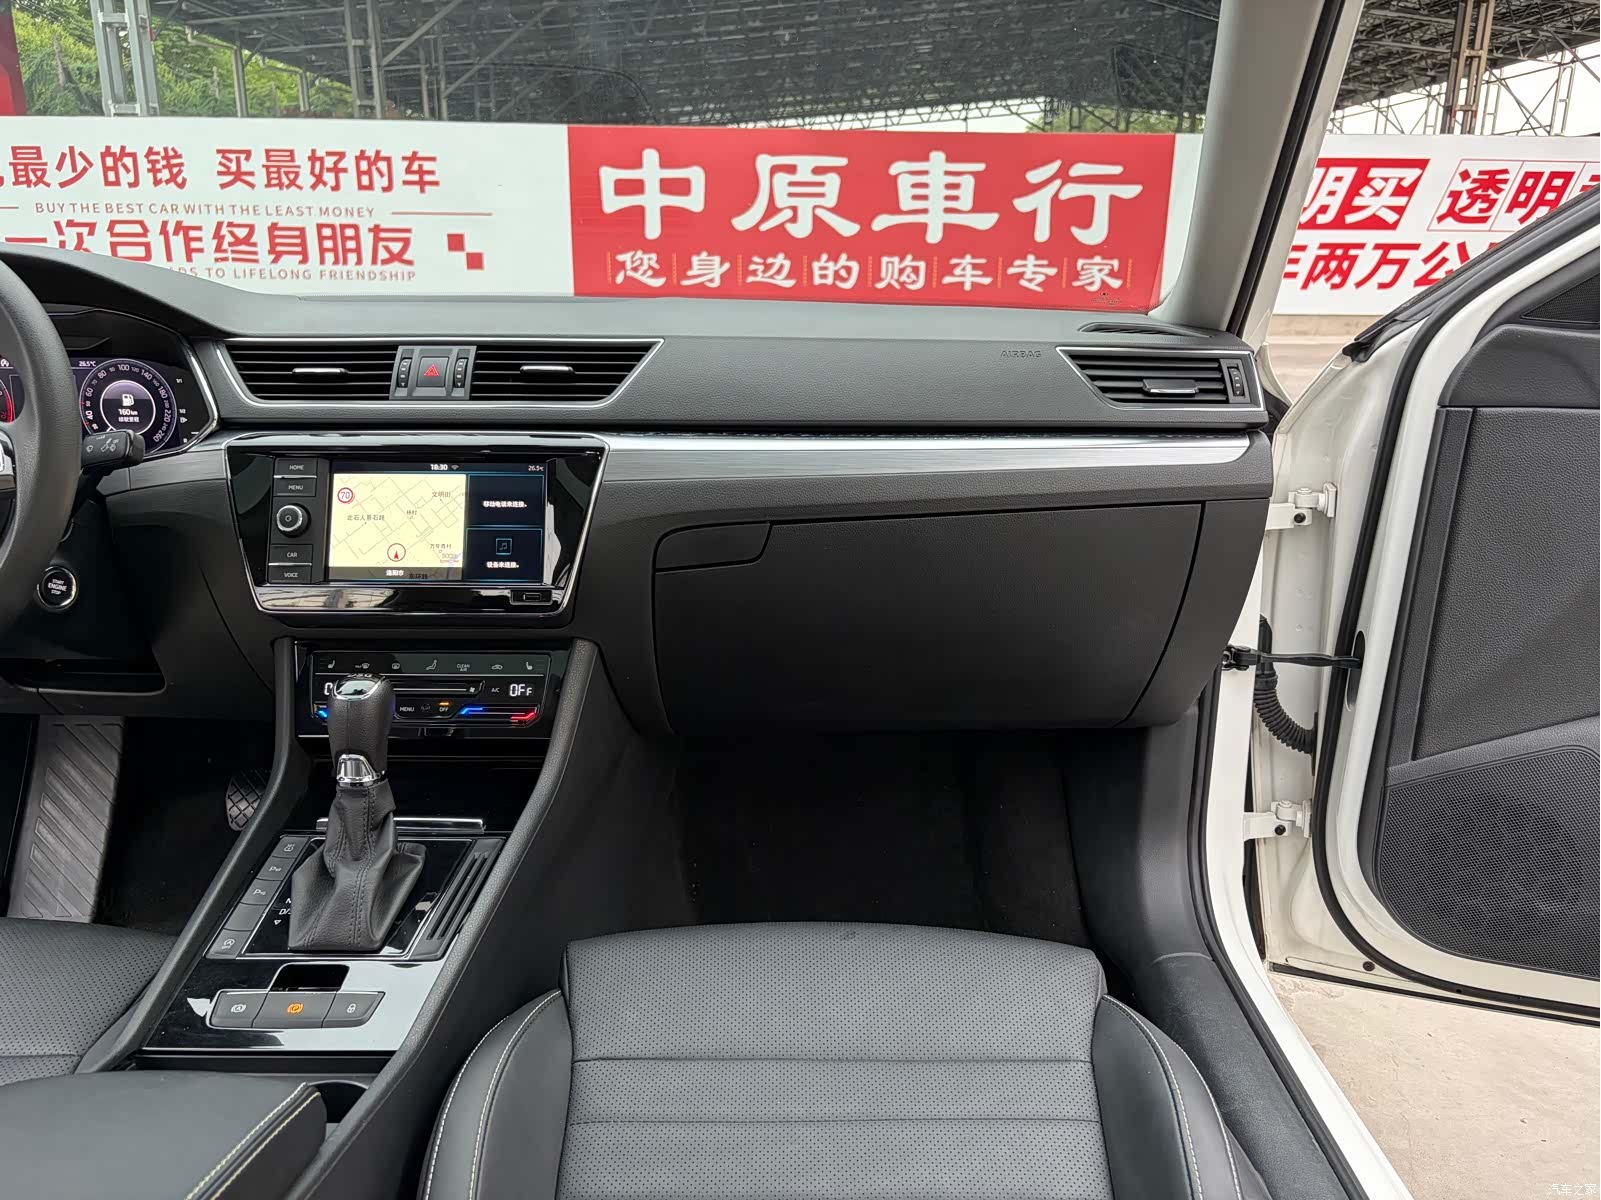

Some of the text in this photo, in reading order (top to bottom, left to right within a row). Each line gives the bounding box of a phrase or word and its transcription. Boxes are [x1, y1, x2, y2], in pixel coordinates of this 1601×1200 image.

[0, 145, 441, 194] 最少的钱 买最好的车
[600, 148, 1143, 246] 中原車行
[1436, 168, 1601, 224] 透明
[36, 202, 375, 218] BUY THE BEST CAR WITH THE LEAST MONEY
[5, 219, 415, 266] 一次合作终身朋友
[615, 251, 1122, 292] 您身边的购车专家
[1283, 241, 1500, 290] 两万公
[205, 267, 226, 278] TO
[233, 268, 312, 280] LIFELONG
[319, 270, 416, 281] FRIENDSHIP
[1000, 350, 1041, 358] AIRBAG
[98, 370, 107, 379] 80
[141, 369, 153, 380] 140
[85, 387, 93, 397] 60
[158, 386, 168, 398] 180
[86, 410, 94, 420] 40
[153, 430, 165, 442] 260
[340, 491, 351, 500] 70
[47, 582, 67, 592] ENGINE
